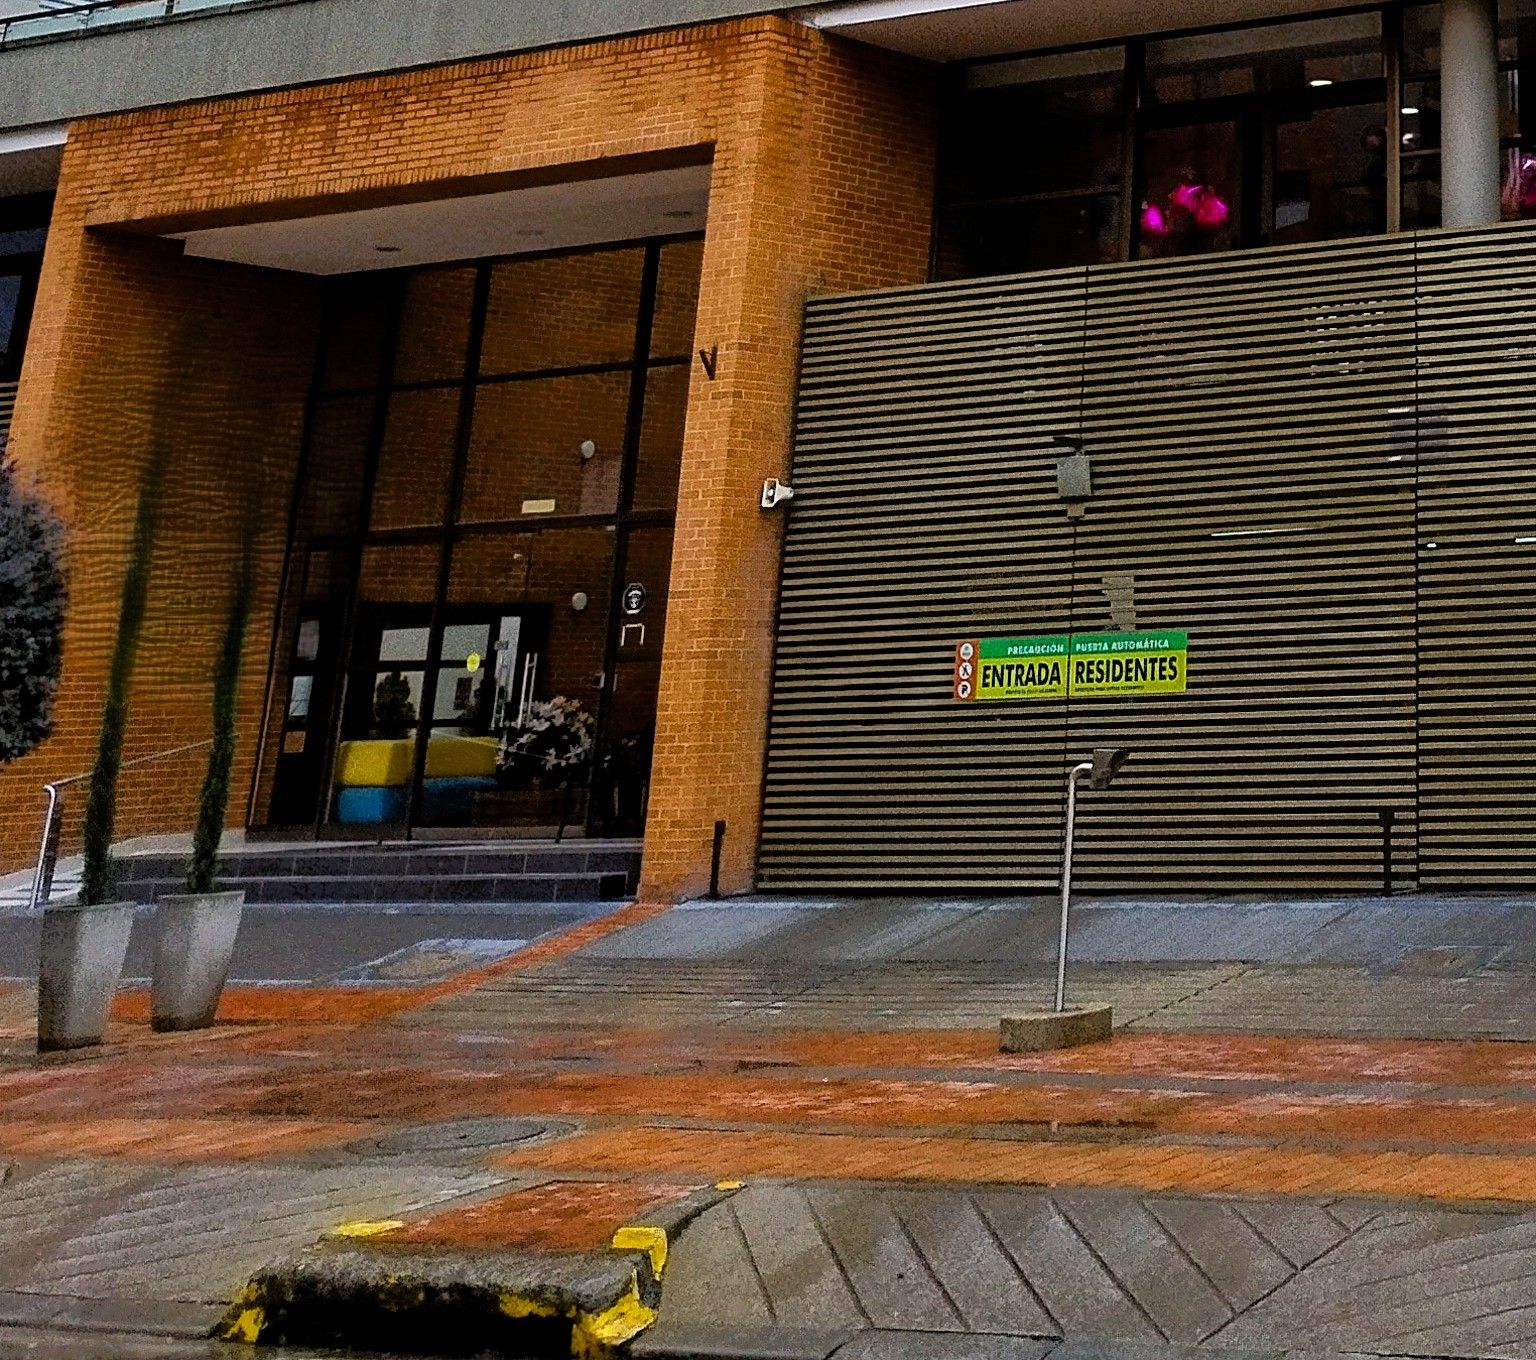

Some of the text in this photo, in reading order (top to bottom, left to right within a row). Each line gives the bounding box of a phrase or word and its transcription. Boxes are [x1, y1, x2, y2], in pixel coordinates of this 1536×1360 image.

[1007, 635, 1170, 656] PRECAUCIÓN PUERTA AUTOMÁTICA
[981, 655, 1178, 689] ENTRADA RESIDENTES
